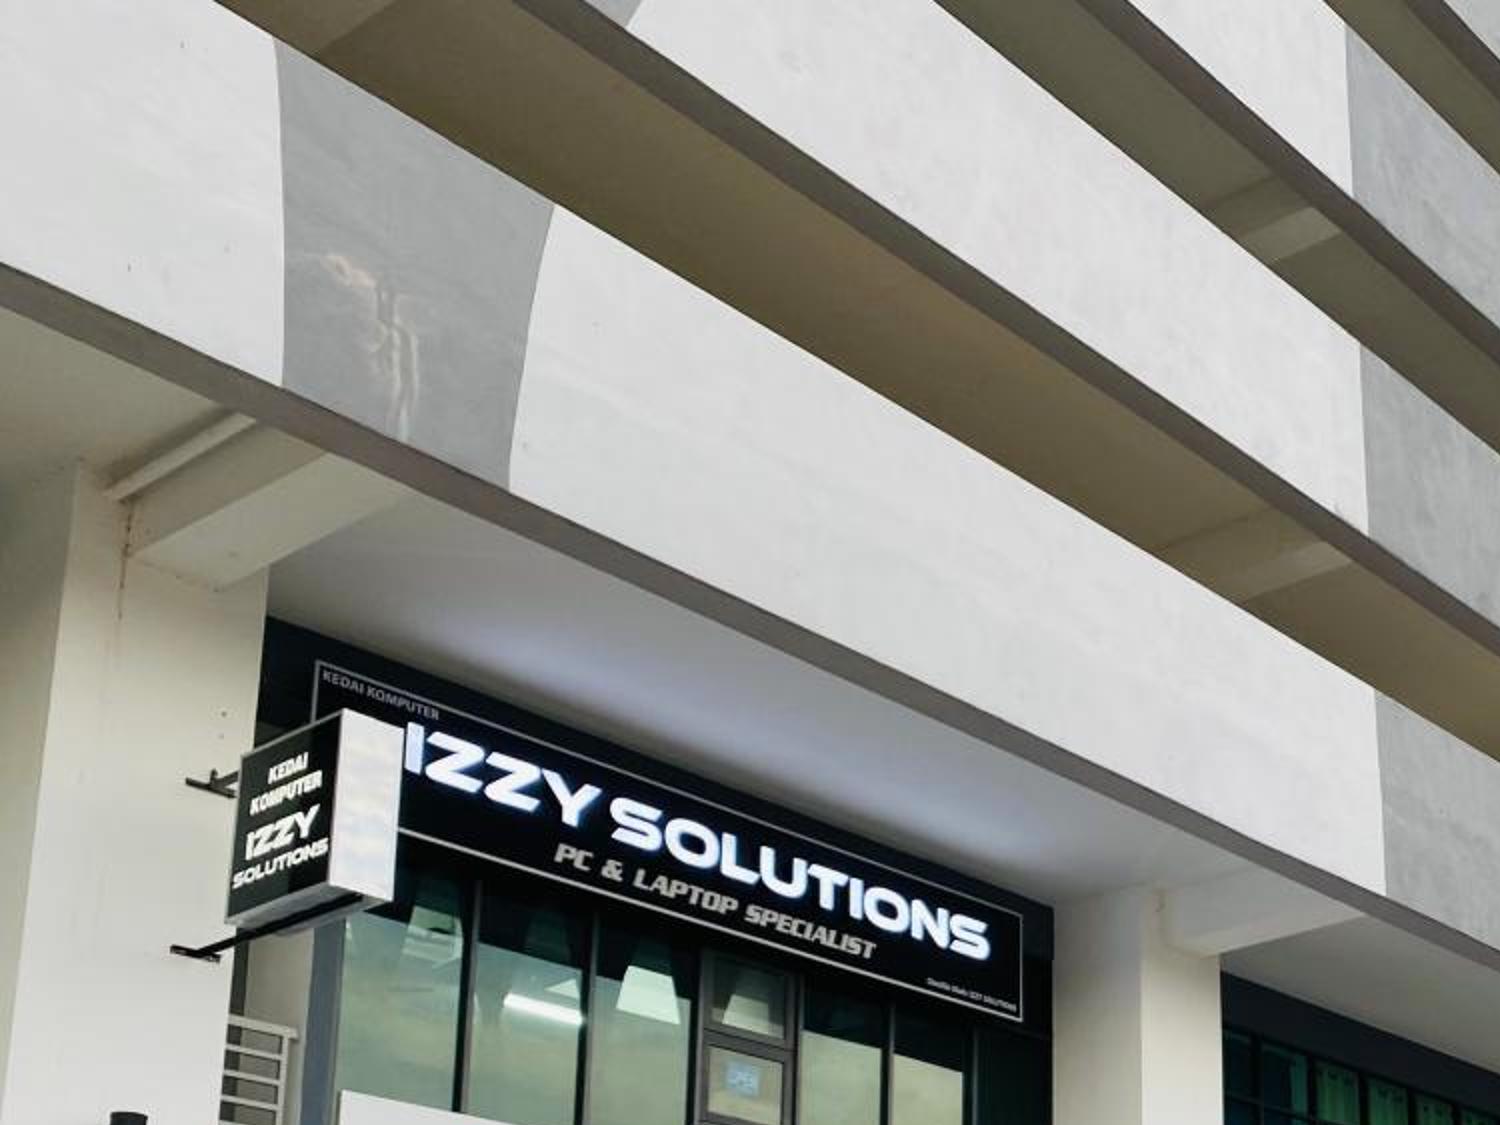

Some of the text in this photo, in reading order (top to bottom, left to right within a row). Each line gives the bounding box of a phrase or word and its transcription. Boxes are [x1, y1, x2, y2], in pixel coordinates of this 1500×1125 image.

[322, 669, 440, 721] KEDAI KOMPUTER
[250, 770, 323, 816] KOMPUTER
[268, 752, 309, 785] KEDAI
[245, 803, 320, 861] IZZY
[404, 721, 992, 961] IZZY SOLUTIONS
[232, 837, 329, 890] SOLUTIONS
[555, 843, 877, 959] PC & LAPTOP SPECIALIST
